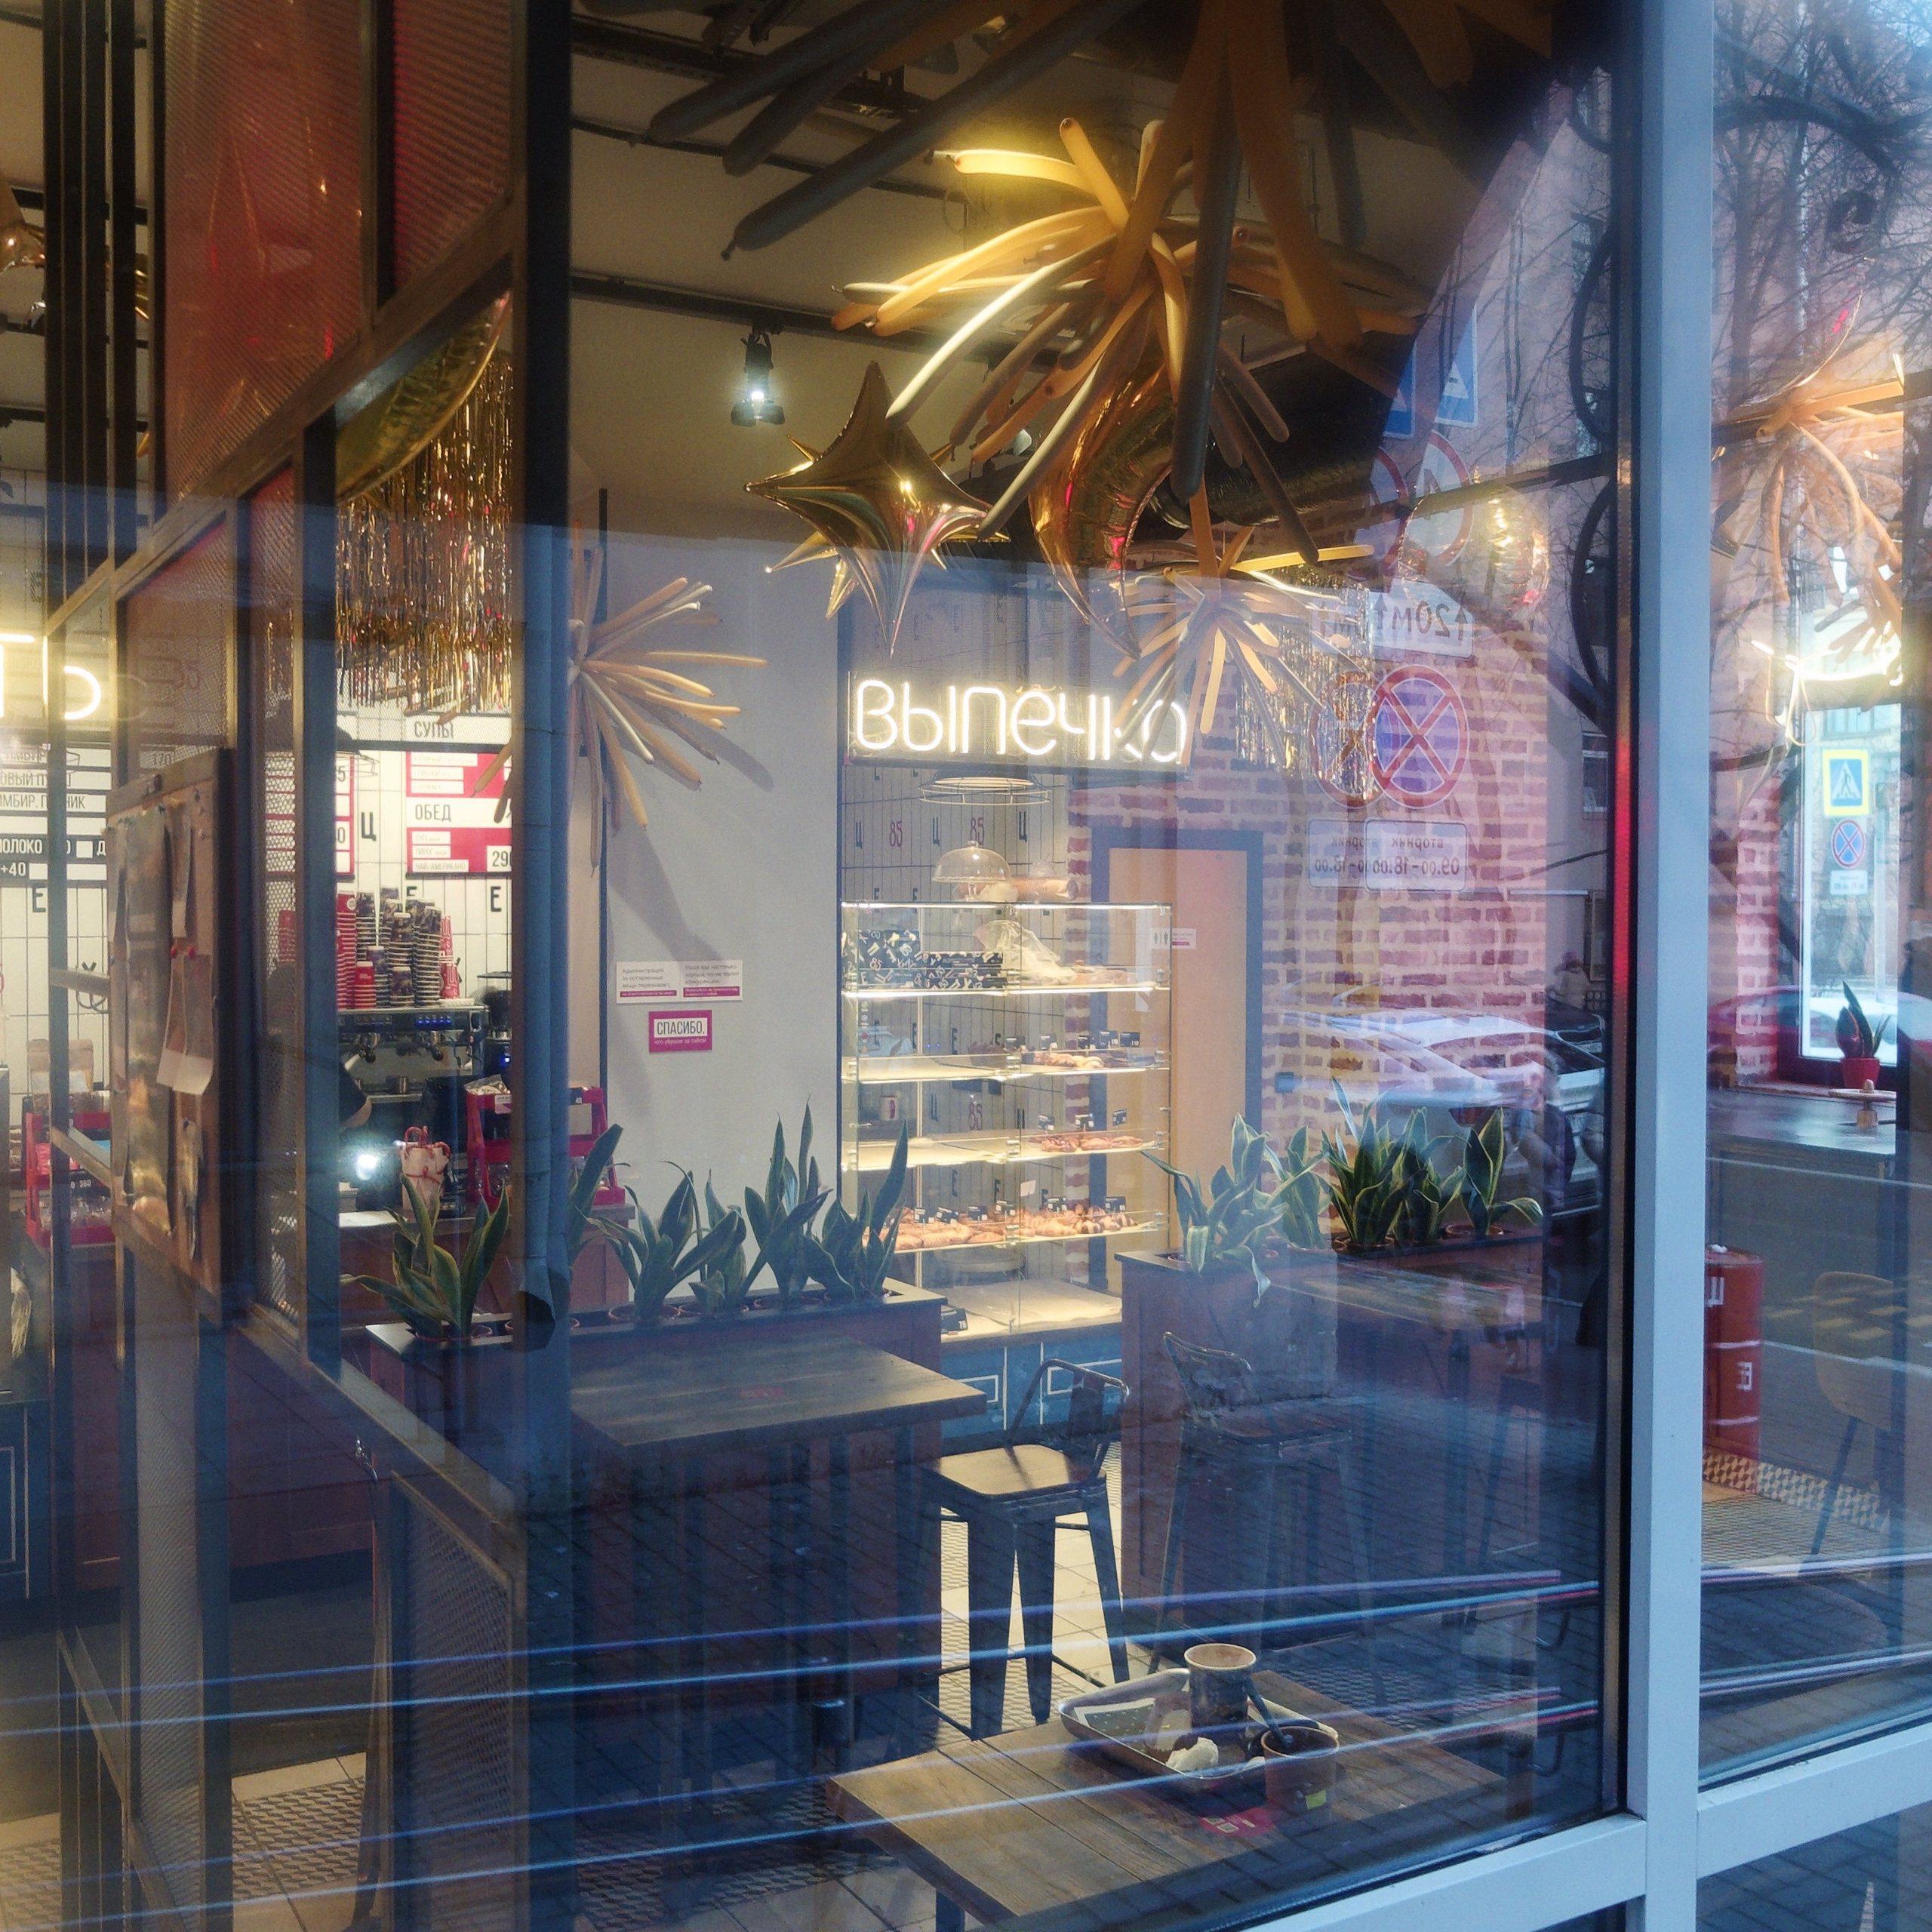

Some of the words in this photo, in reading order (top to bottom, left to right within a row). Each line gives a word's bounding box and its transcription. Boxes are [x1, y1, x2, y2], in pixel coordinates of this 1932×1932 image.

[414, 721, 454, 739] СУПЫ
[415, 804, 451, 822] ОБЕД
[889, 820, 903, 847] 85
[492, 851, 512, 867] 29
